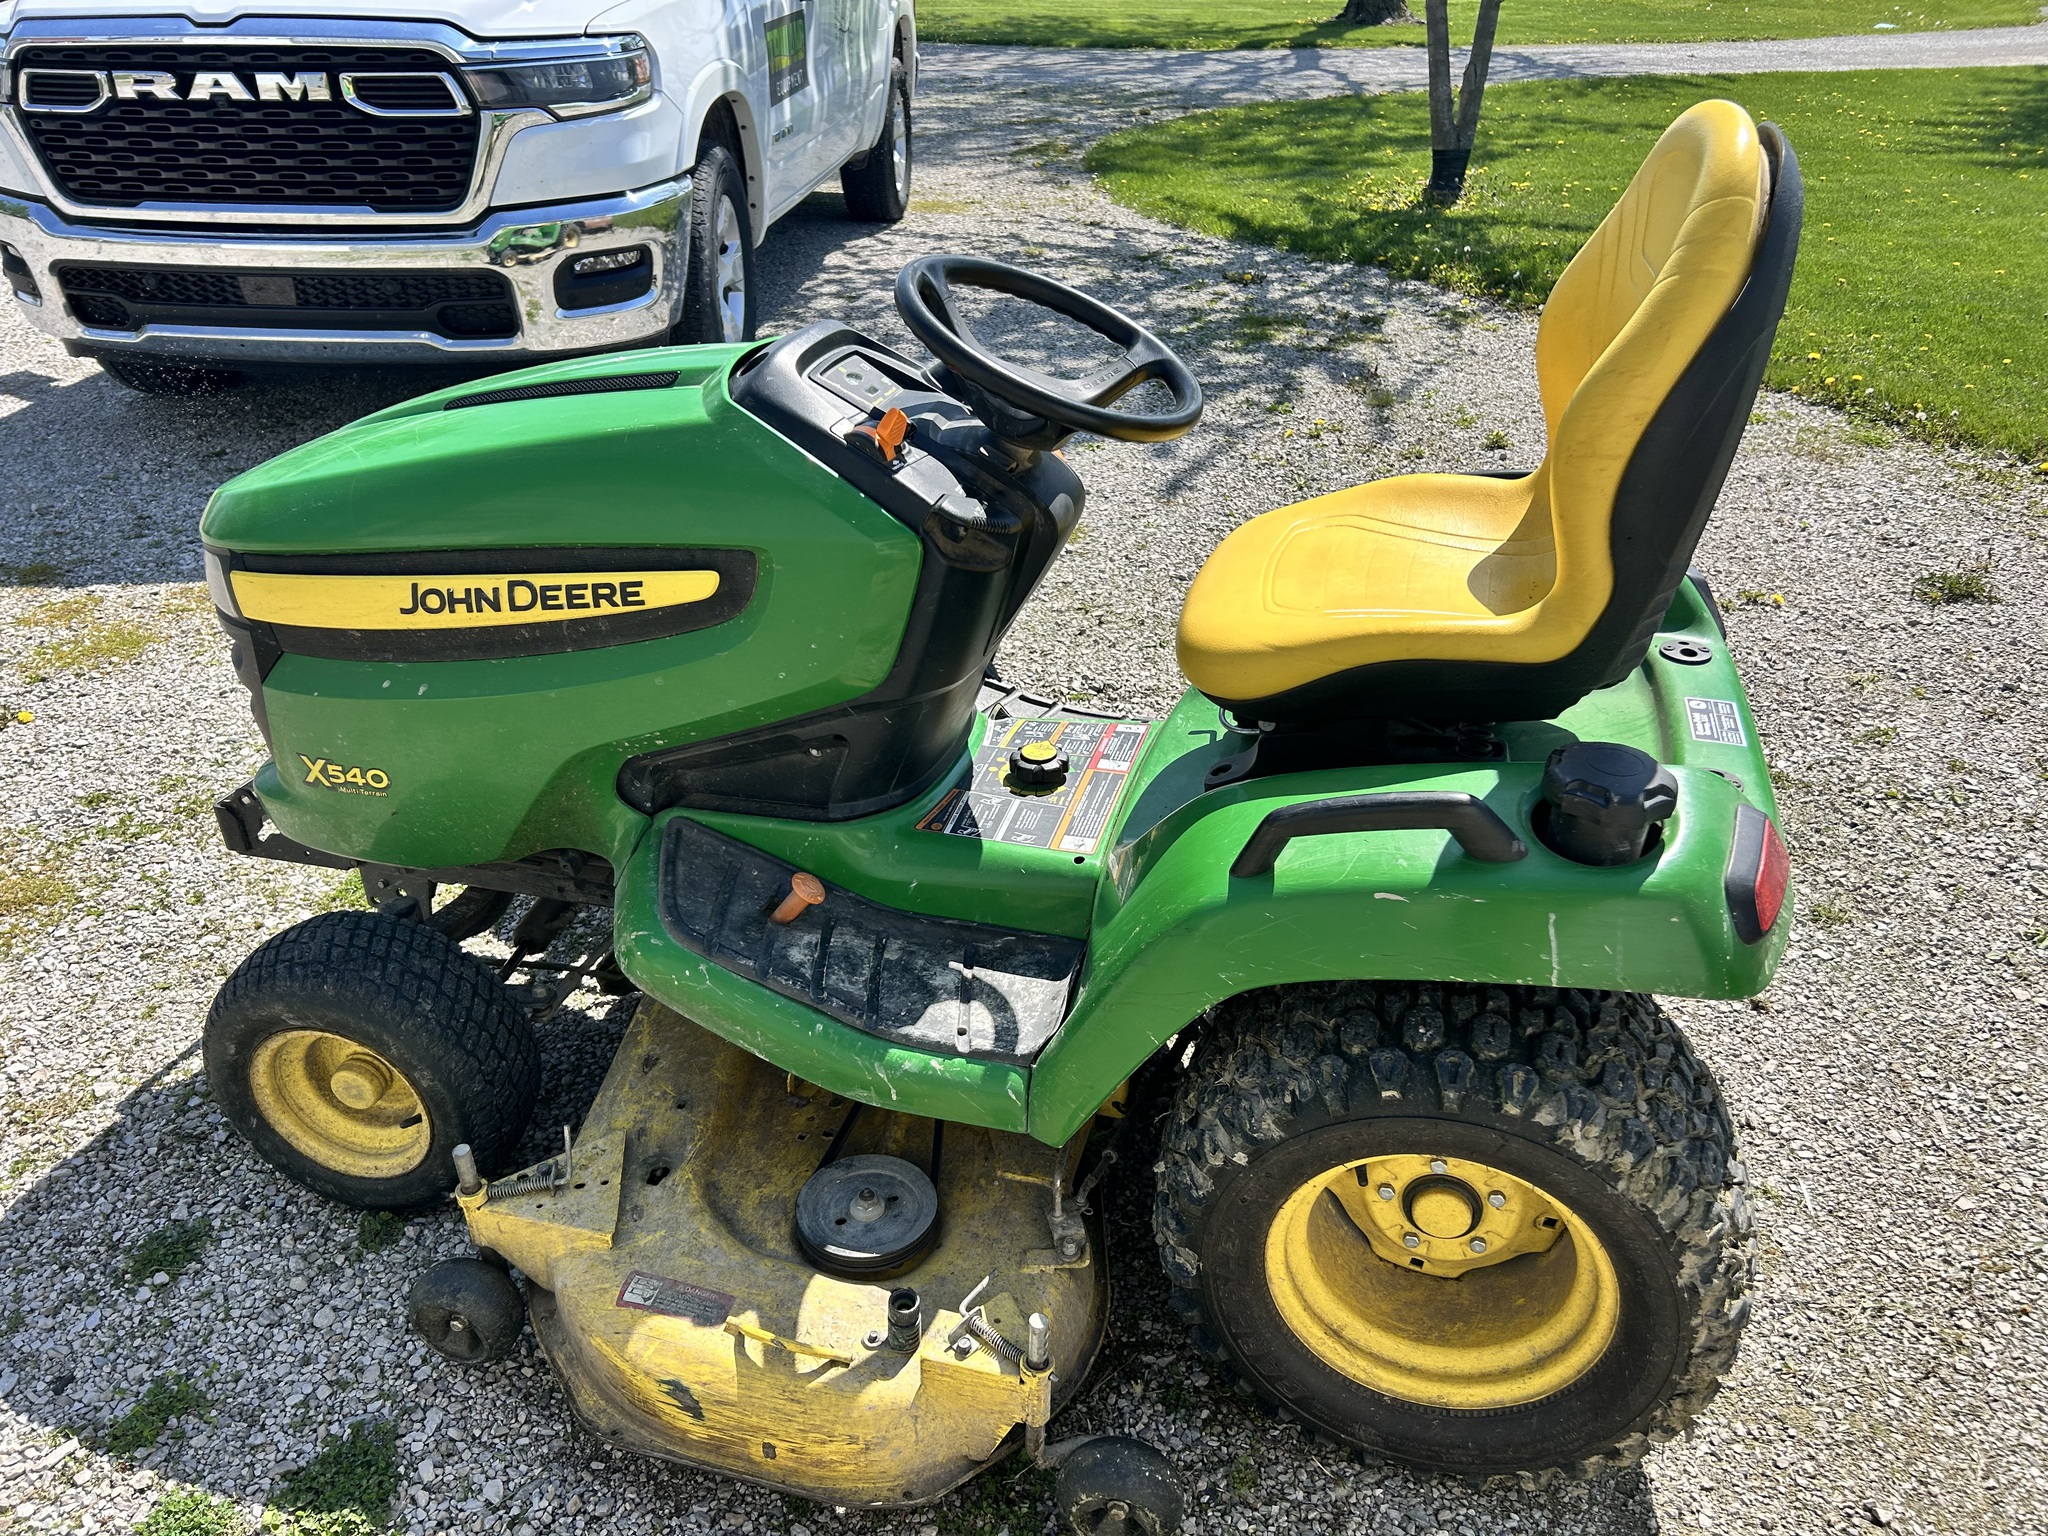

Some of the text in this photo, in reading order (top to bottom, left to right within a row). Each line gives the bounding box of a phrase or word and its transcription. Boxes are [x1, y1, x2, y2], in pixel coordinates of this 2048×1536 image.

[110, 70, 331, 102] RAM
[400, 580, 645, 615] JOHN DEERE
[298, 754, 389, 789] X540
[685, 1287, 717, 1299] DANGER
